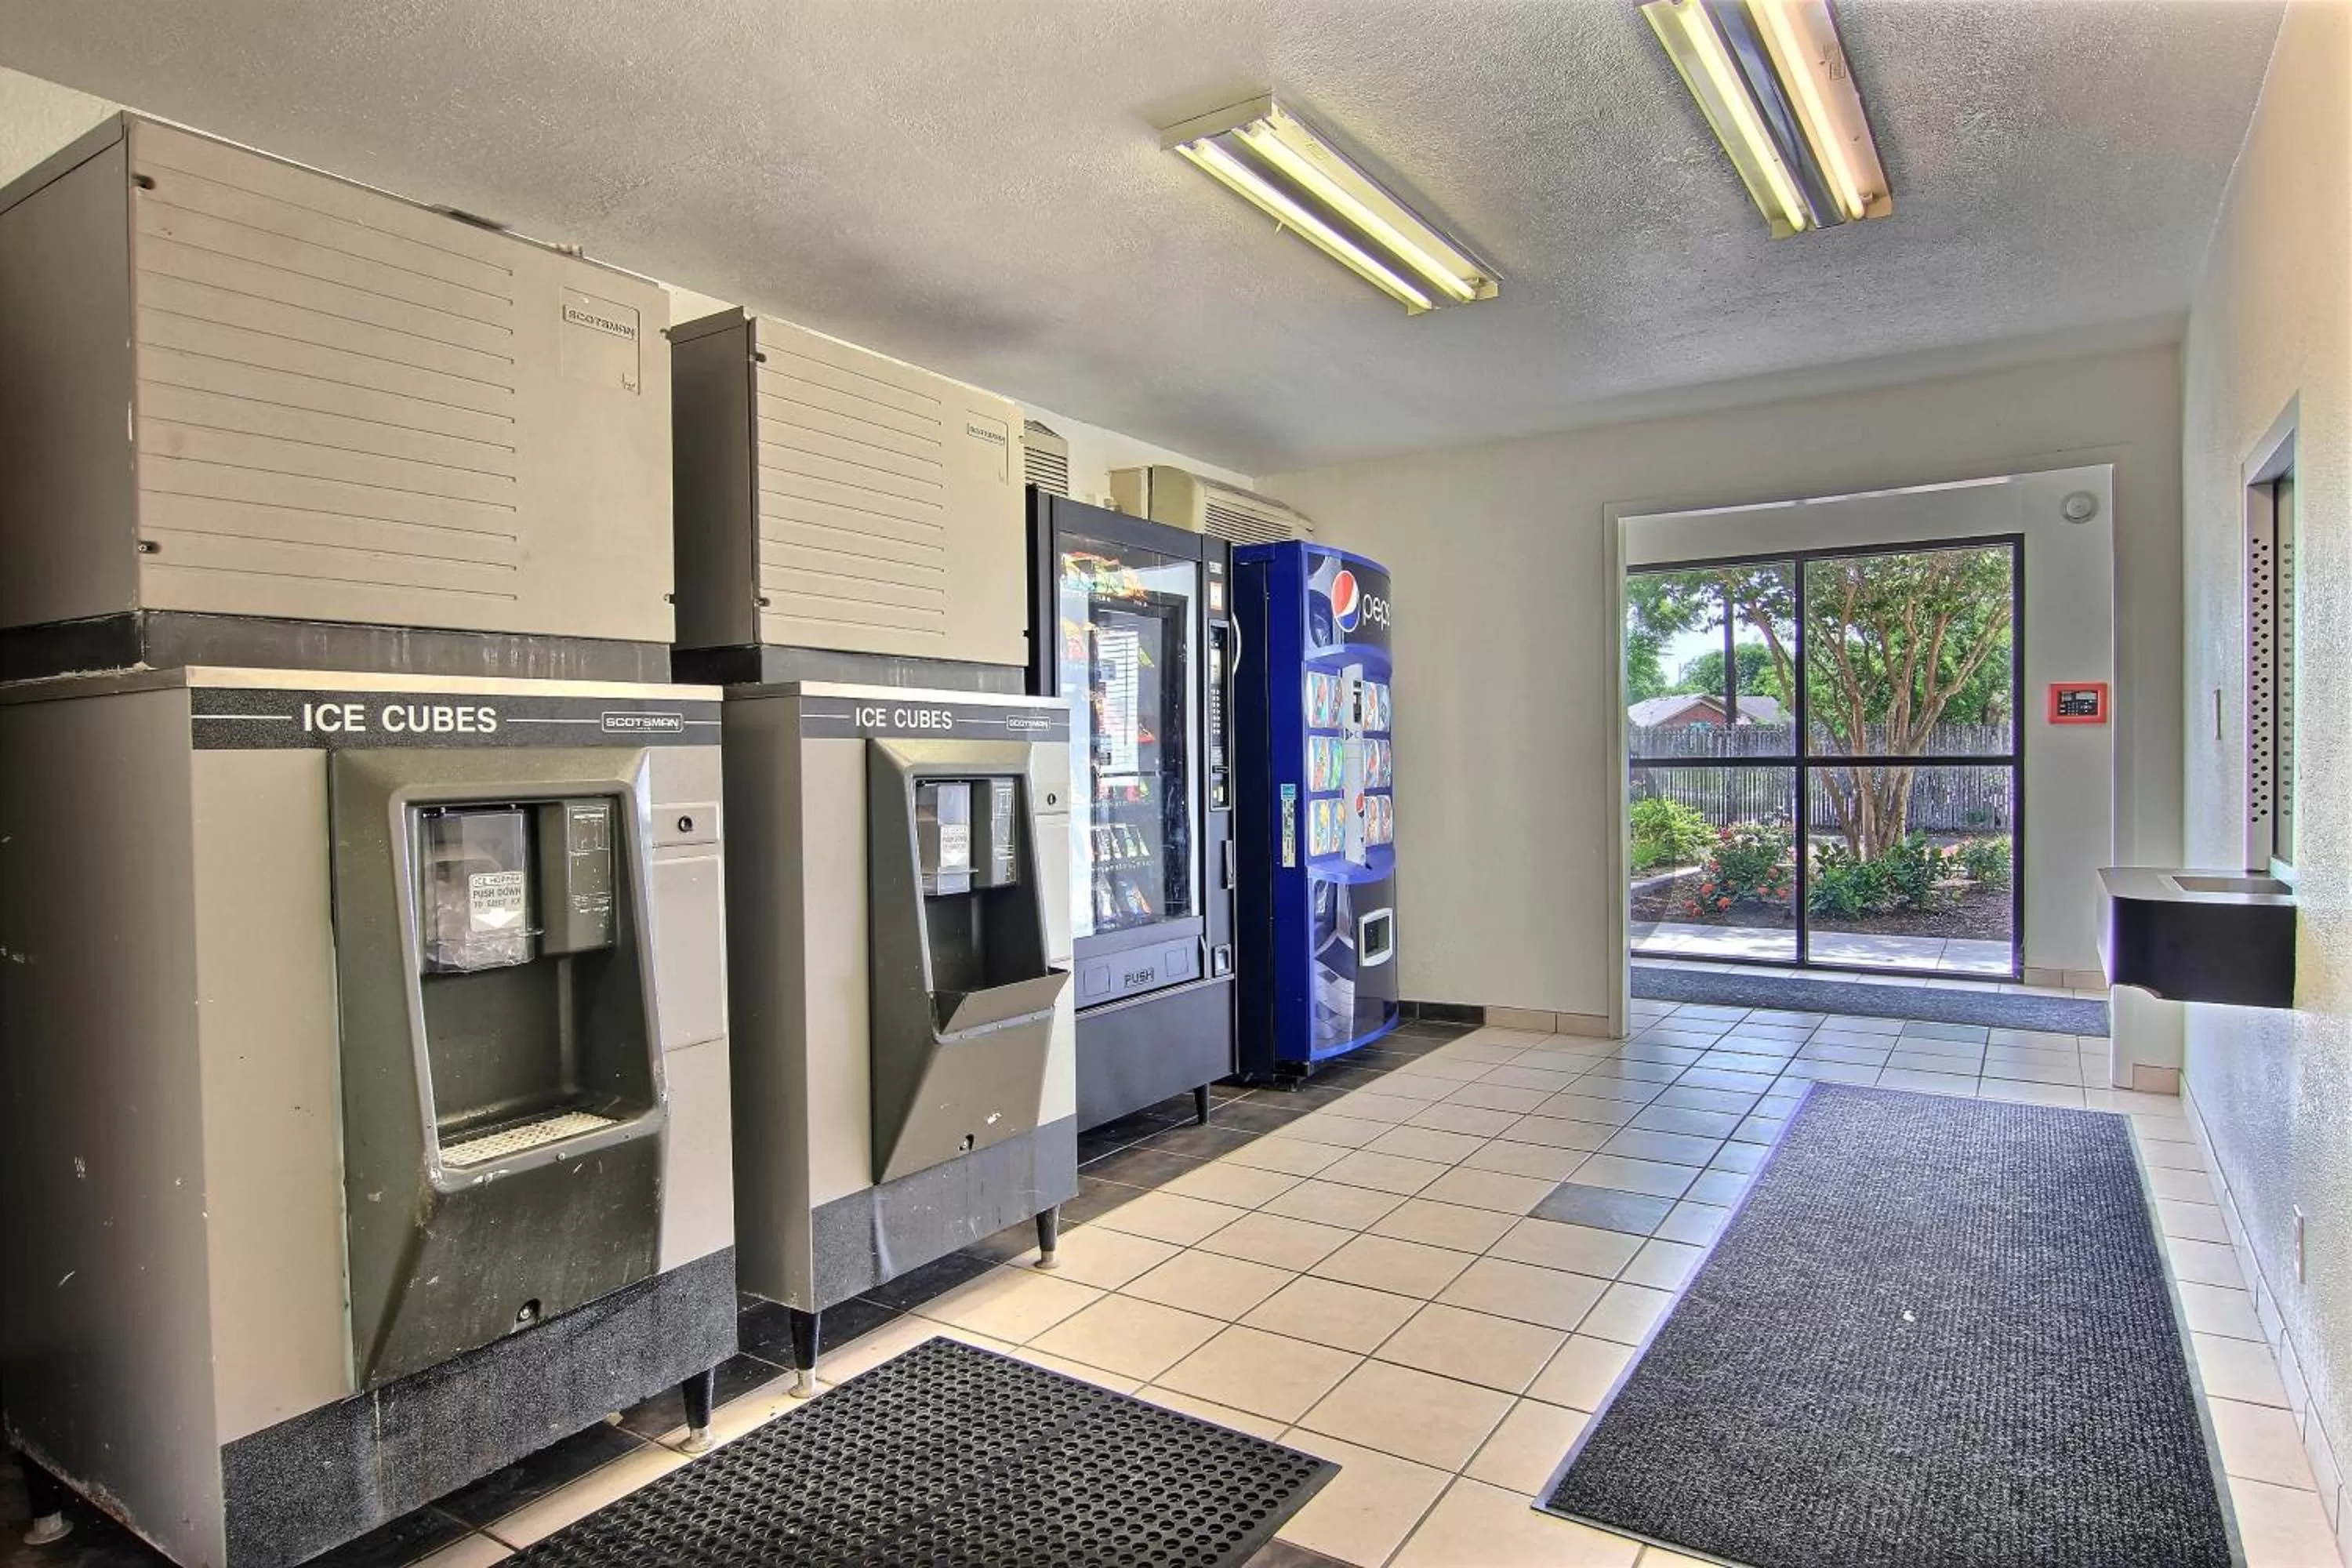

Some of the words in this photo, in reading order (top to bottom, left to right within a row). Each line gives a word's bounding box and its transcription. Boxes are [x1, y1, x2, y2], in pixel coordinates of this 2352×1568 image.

[303, 703, 366, 732] ICE
[382, 705, 498, 733] CUBES
[606, 717, 679, 728] SCOTSMAN
[855, 707, 887, 727] ICE
[895, 708, 953, 730] CUBES
[473, 888, 495, 899] PUSH
[497, 887, 521, 897] DOWN
[1123, 967, 1155, 989] PUSH
